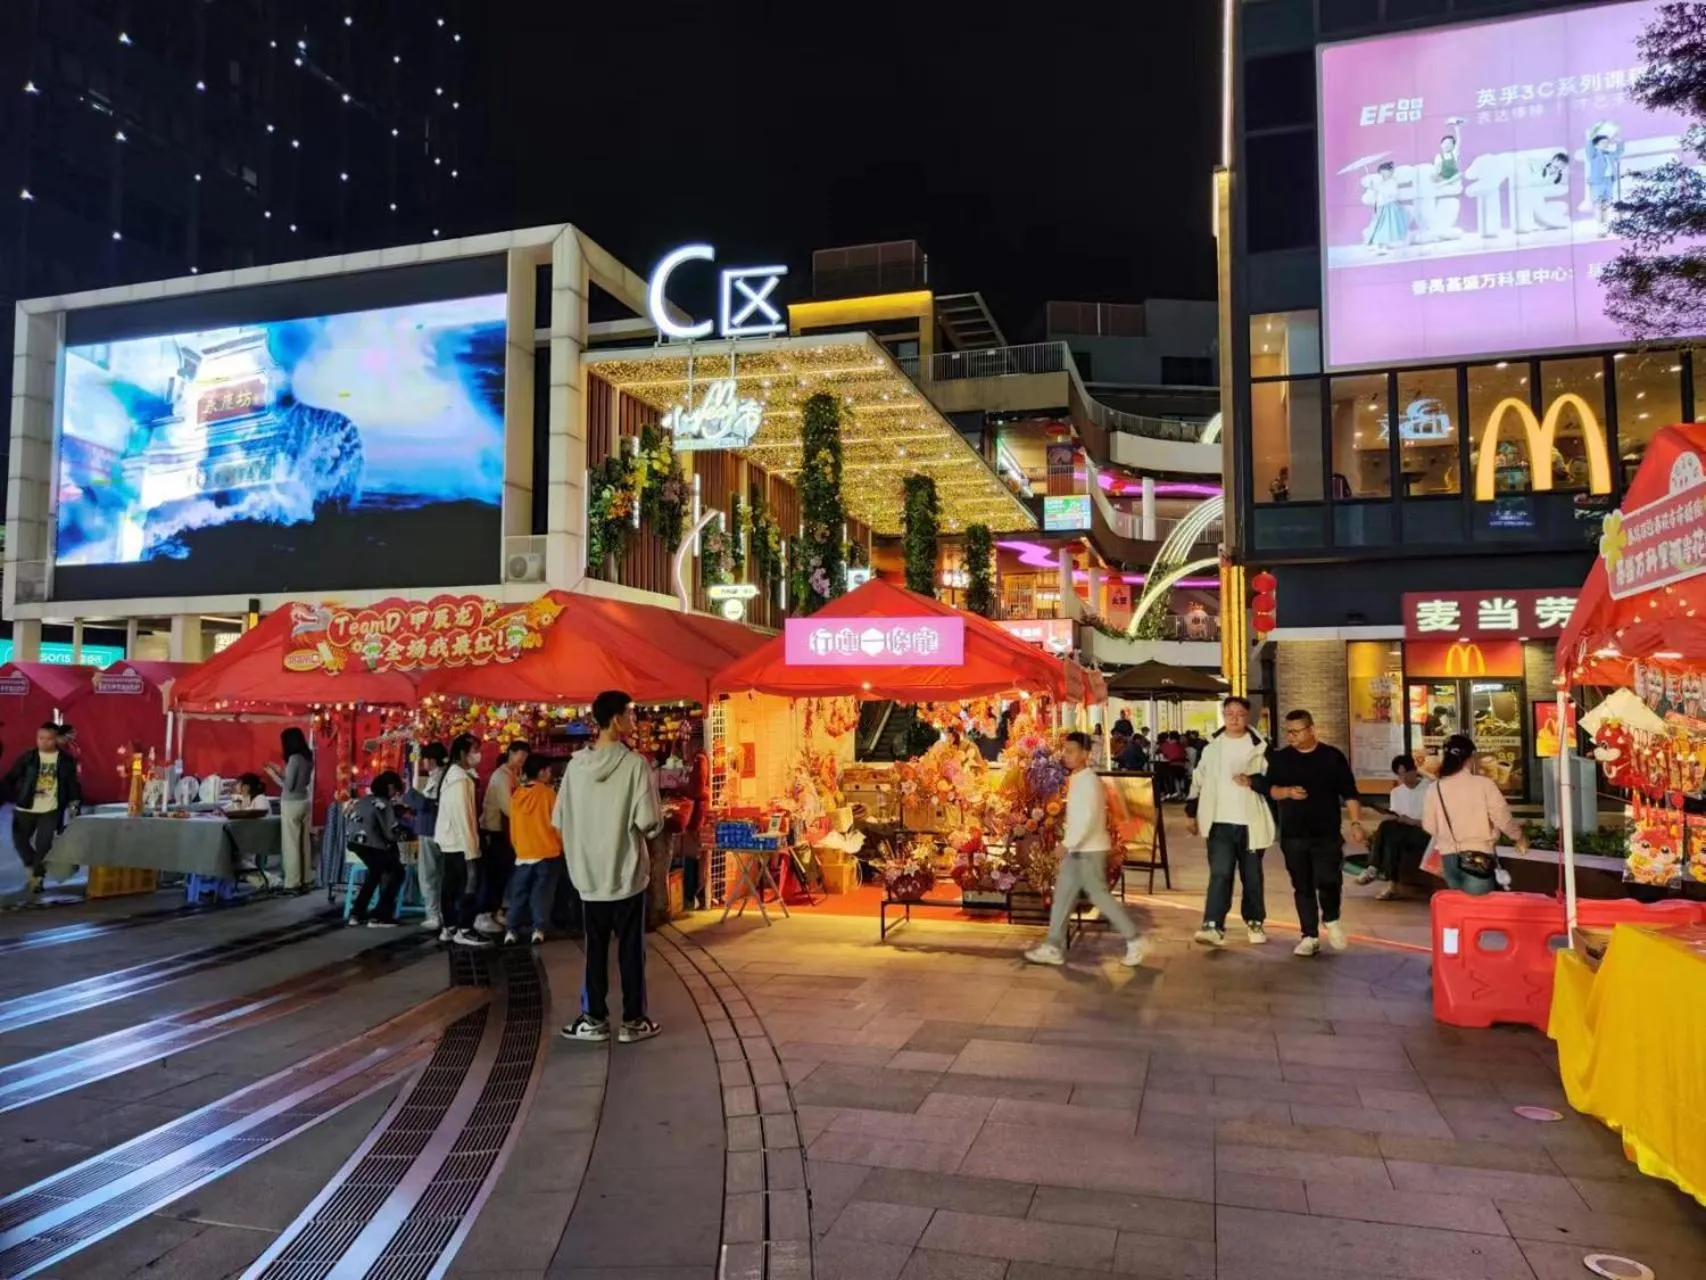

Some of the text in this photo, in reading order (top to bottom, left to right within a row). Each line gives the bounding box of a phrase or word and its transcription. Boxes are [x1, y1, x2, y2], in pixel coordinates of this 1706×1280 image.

[649, 244, 788, 338] C区
[1416, 596, 1578, 632] 麦当劳
